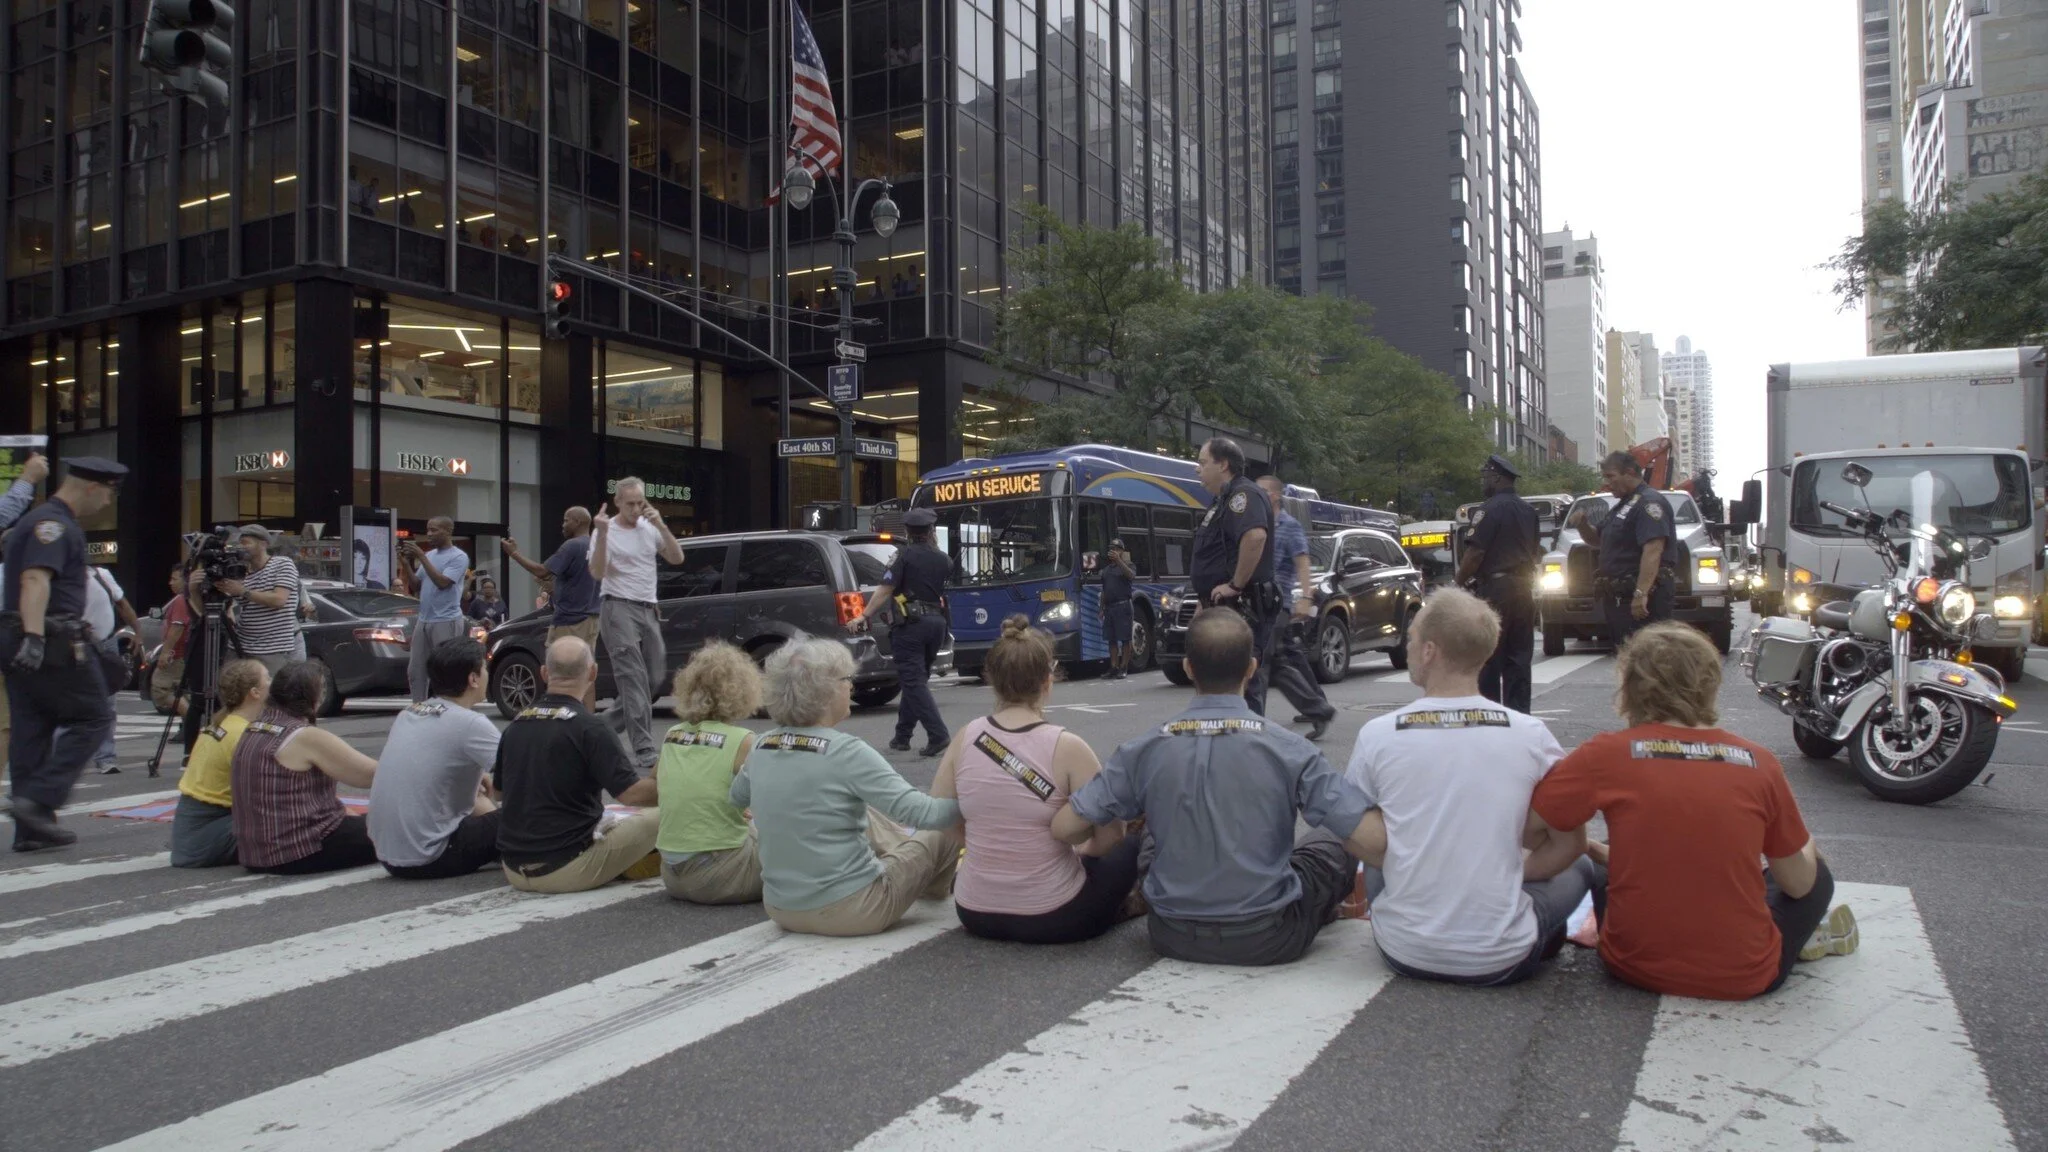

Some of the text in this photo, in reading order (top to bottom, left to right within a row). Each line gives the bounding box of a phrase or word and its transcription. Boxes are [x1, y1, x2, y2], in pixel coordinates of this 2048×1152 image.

[782, 441, 831, 453] East 40th St
[861, 442, 893, 455] Third Ave
[235, 452, 269, 472] HSBC
[397, 452, 444, 472] HSBC
[607, 479, 691, 500] SBUCKS
[935, 473, 1041, 502] NOT IN SERVICE
[1162, 718, 1262, 732] #CUOMOWALKTHETALK
[1400, 711, 1506, 725] #CUOMOWALKTHETALK
[1635, 740, 1751, 761] #CUOMOWALKTHETALK
[978, 734, 1052, 795] #CUOMOWALKTHETALK
